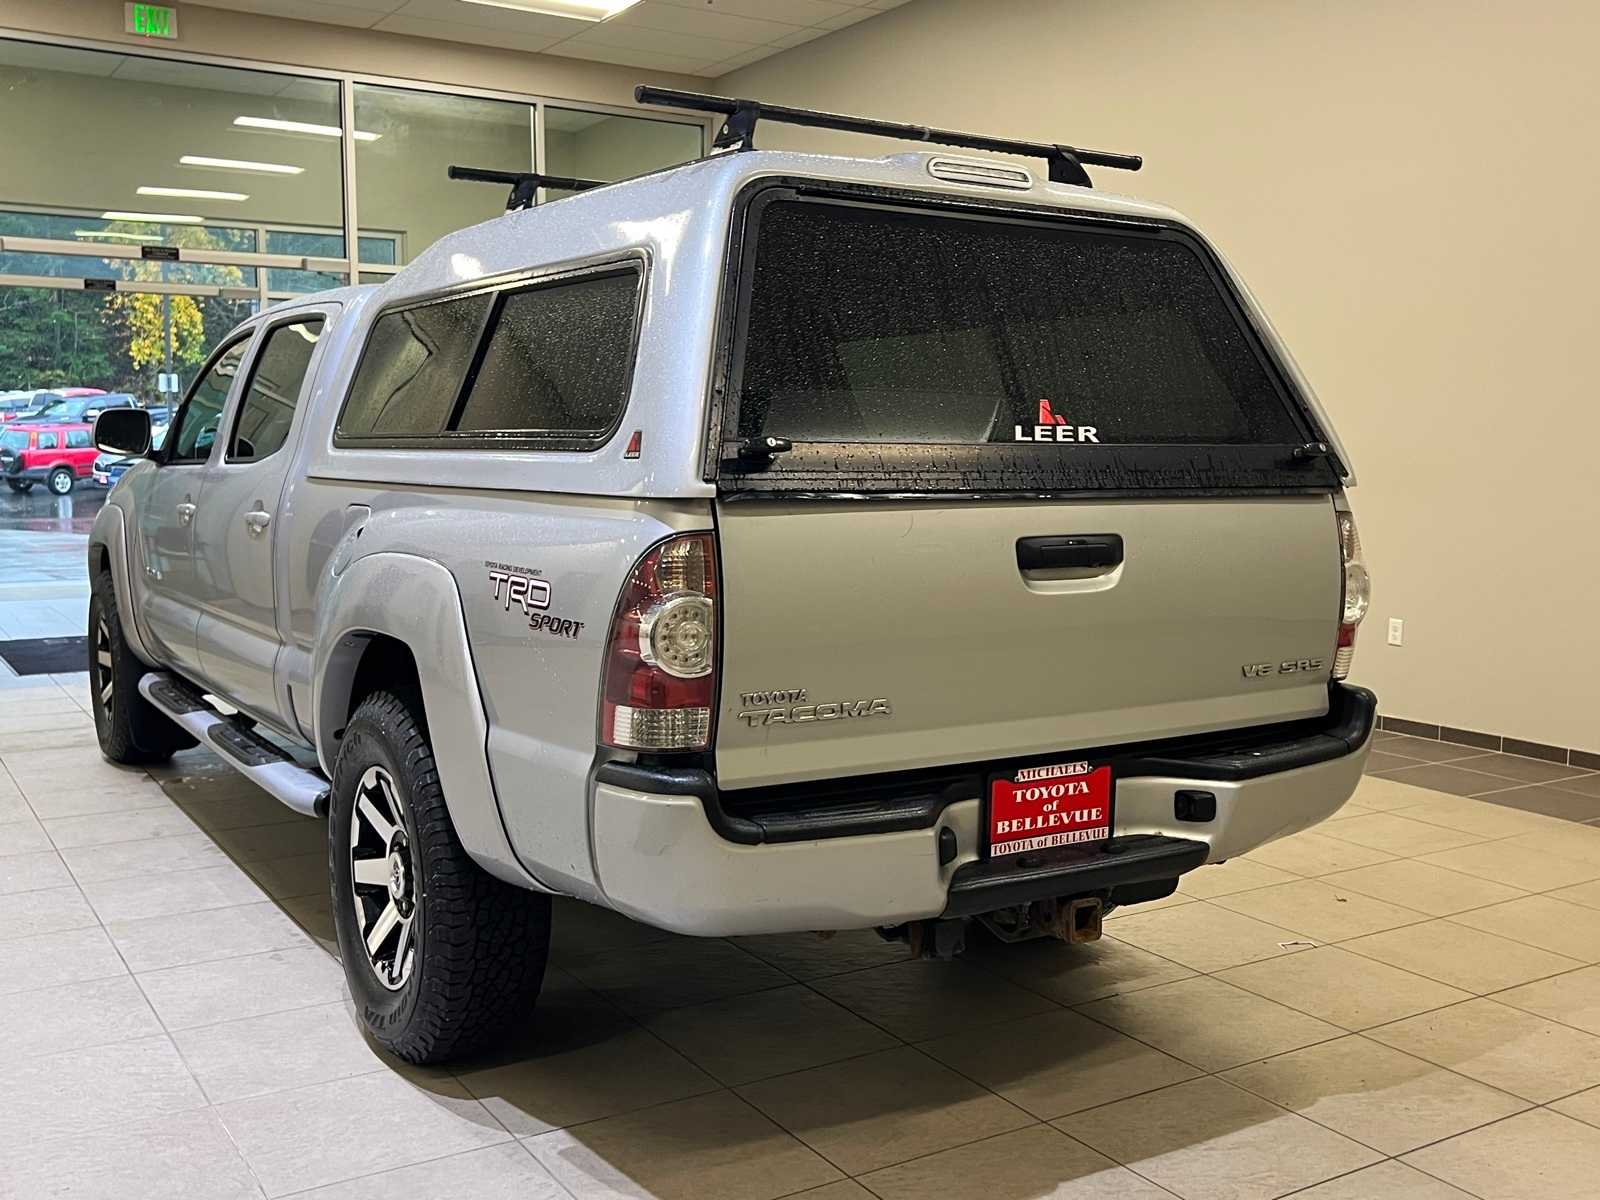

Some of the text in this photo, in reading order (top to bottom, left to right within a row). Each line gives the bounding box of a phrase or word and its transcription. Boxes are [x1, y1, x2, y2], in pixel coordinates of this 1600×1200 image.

[1014, 425, 1100, 443] LEER
[489, 571, 552, 616] TRD
[529, 613, 581, 639] SPORT
[740, 688, 808, 707] TOYOTA
[736, 697, 892, 728] TACOMA
[1019, 763, 1087, 780] MICHAELS
[1013, 781, 1090, 803] TOYOTA
[1043, 800, 1060, 812] of
[996, 807, 1103, 834] BELLEVUE
[992, 828, 1107, 856] TOYOTA of BELLEVUE
